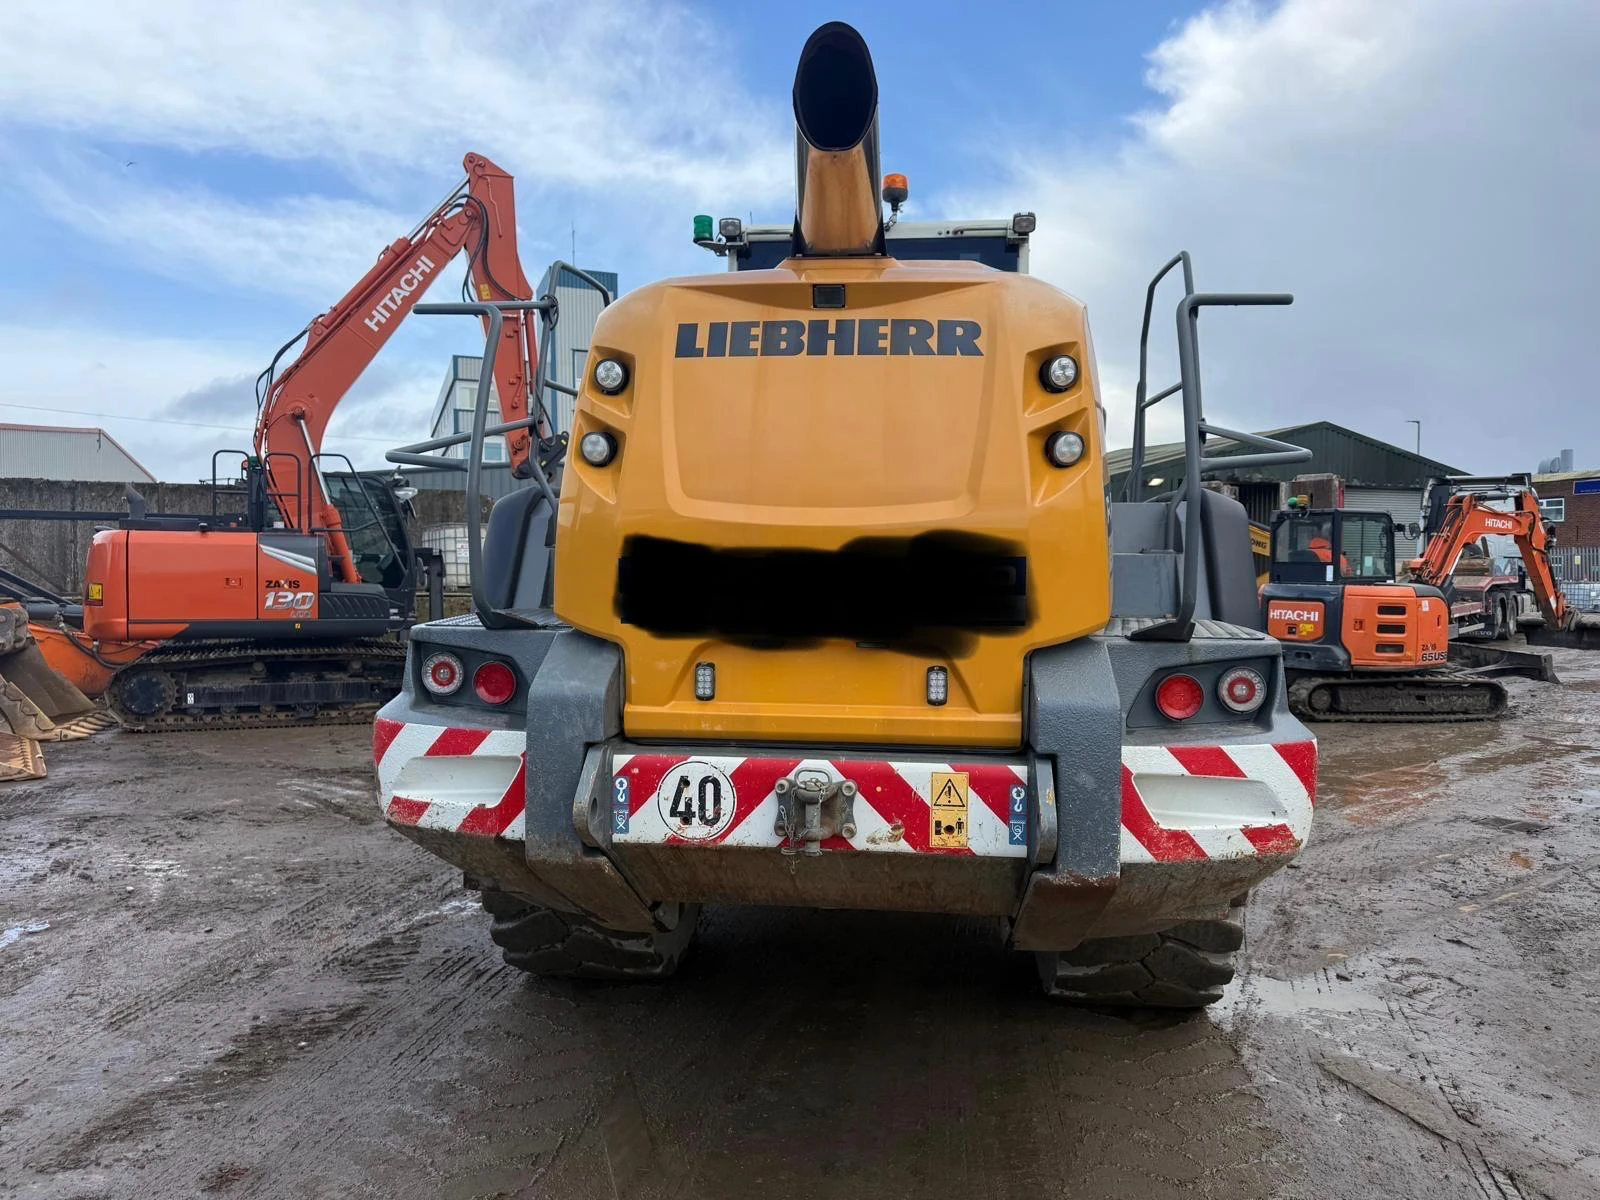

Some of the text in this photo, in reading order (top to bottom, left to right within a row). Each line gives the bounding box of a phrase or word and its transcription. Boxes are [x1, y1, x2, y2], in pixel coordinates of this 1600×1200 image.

[364, 255, 435, 332] HITACHI
[674, 318, 984, 358] LIEBHERR
[1485, 517, 1513, 530] HITACHI
[264, 591, 315, 610] 130
[1270, 608, 1319, 621] HITACHI
[669, 775, 722, 827] 40
